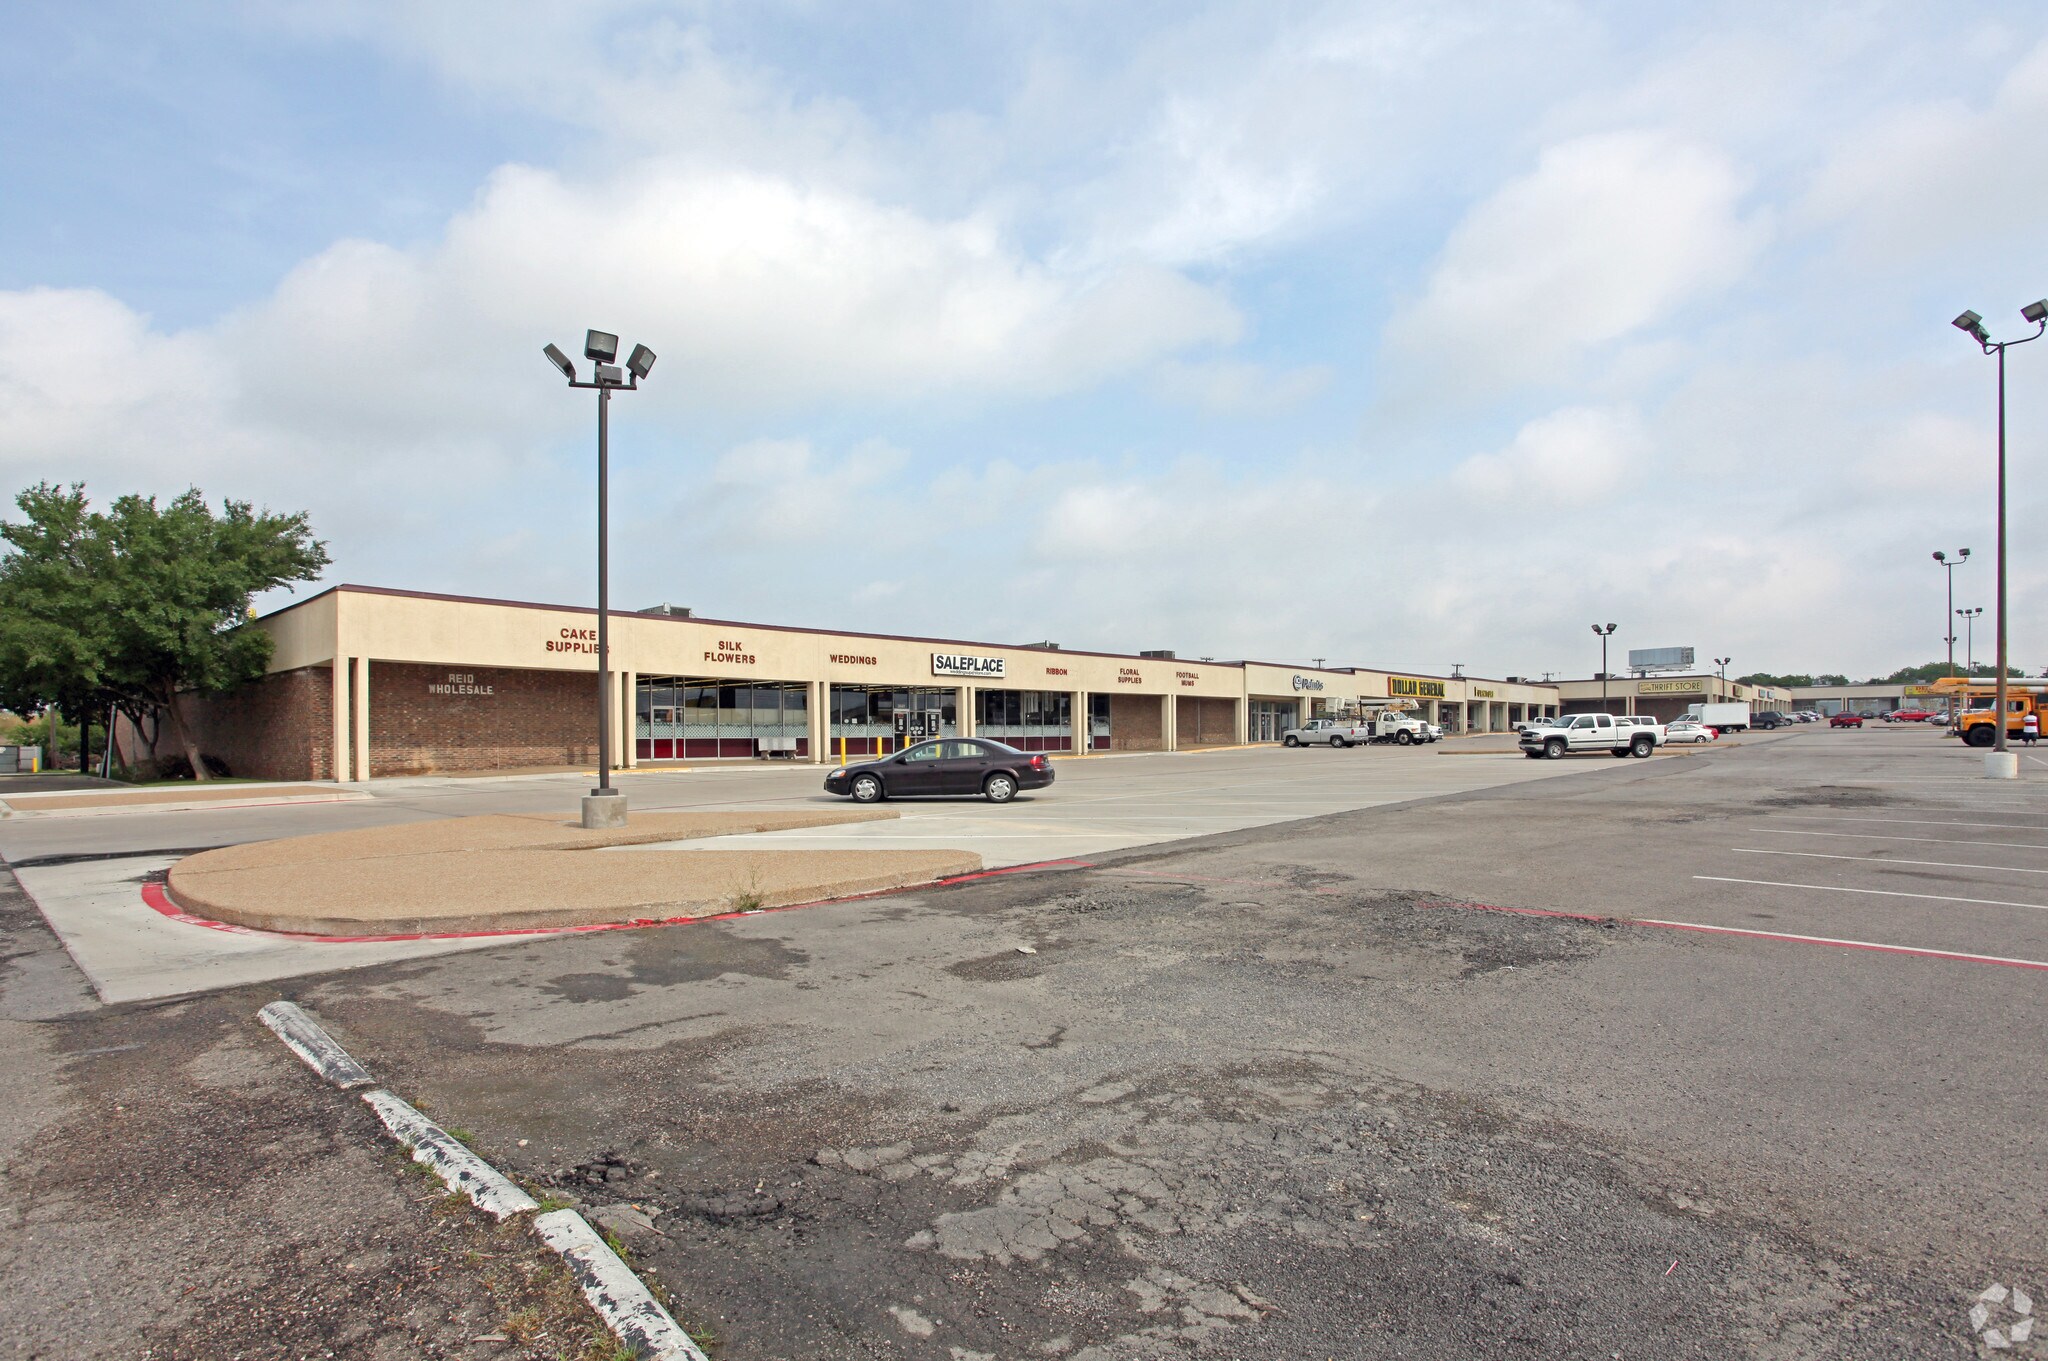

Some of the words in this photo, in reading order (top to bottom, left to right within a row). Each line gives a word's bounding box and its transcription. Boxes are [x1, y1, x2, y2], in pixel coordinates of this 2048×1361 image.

[560, 628, 597, 641] CAKE
[718, 641, 742, 652] SILK
[704, 652, 756, 665] FLOWERS
[829, 654, 877, 666] WEDDINGS
[935, 655, 1004, 673] SALEPLACE
[1046, 667, 1068, 676] RIBBON
[1119, 668, 1140, 676] FLORAL
[1176, 672, 1199, 680] FOOTBALL
[448, 673, 474, 684] REID
[1117, 677, 1142, 685] SUPPLIES
[428, 684, 494, 696] WHOLESALE
[1392, 679, 1417, 696] DOLLAR
[1419, 681, 1445, 697] GENERAL
[1651, 683, 1673, 692] THRIFT
[1675, 682, 1700, 691] STORE
